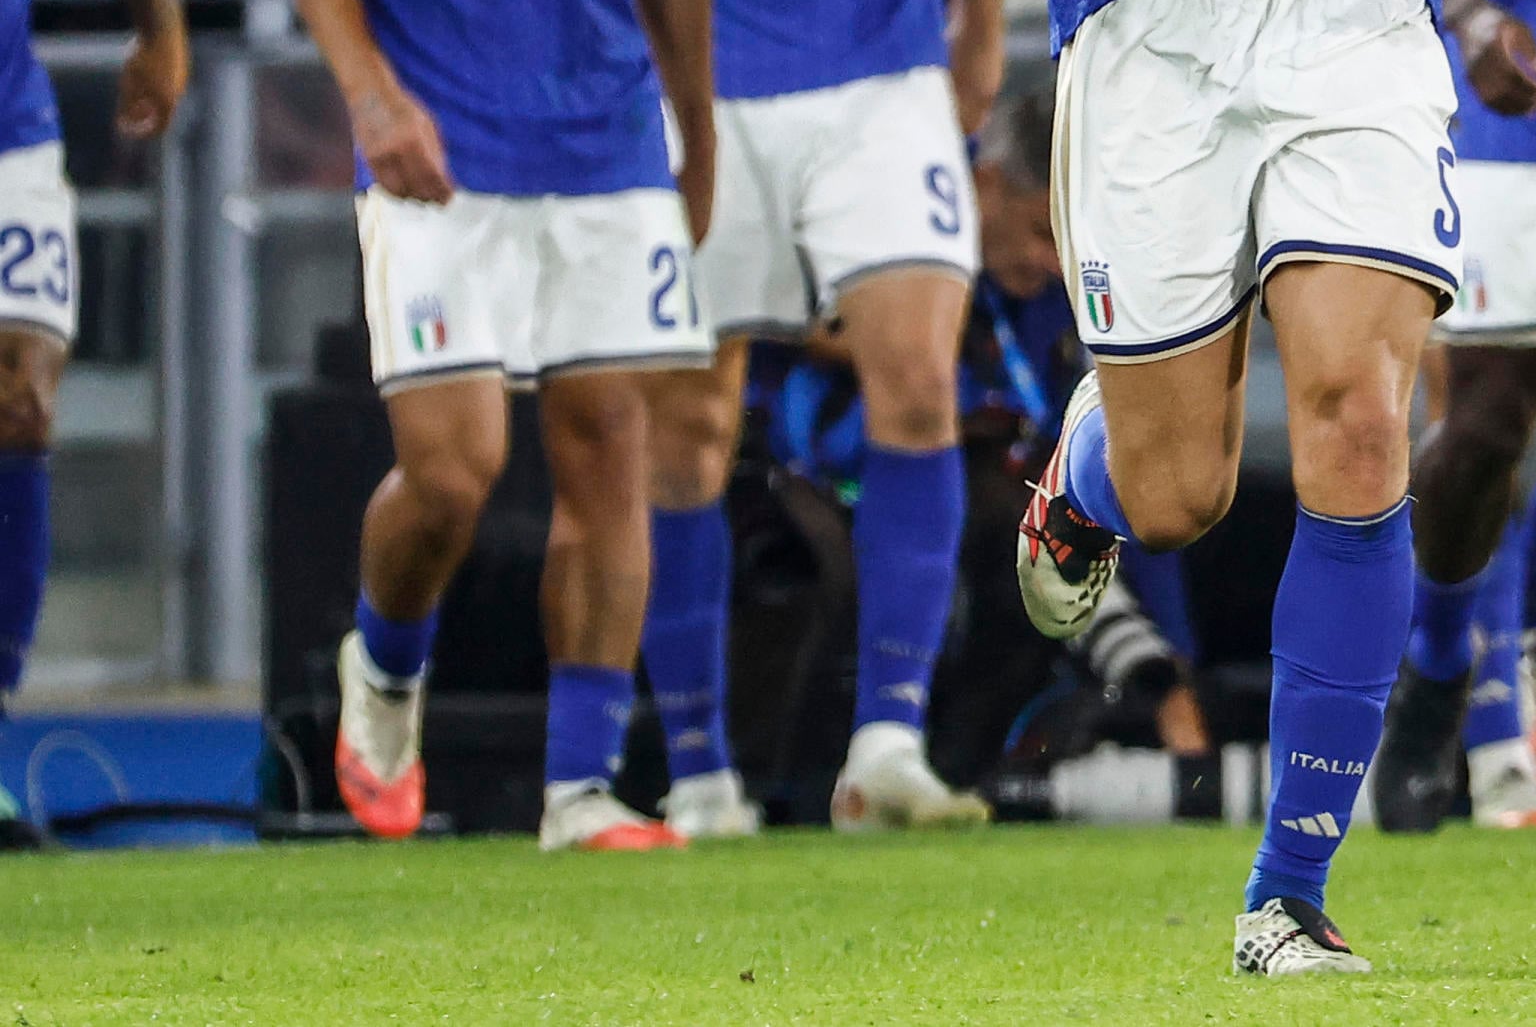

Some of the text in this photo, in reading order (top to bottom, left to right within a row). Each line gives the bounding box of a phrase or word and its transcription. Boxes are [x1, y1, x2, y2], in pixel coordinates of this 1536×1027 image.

[924, 164, 960, 235] 9
[1434, 146, 1461, 248] 5
[0, 225, 69, 303] 23
[1290, 752, 1364, 776] ITALIA
